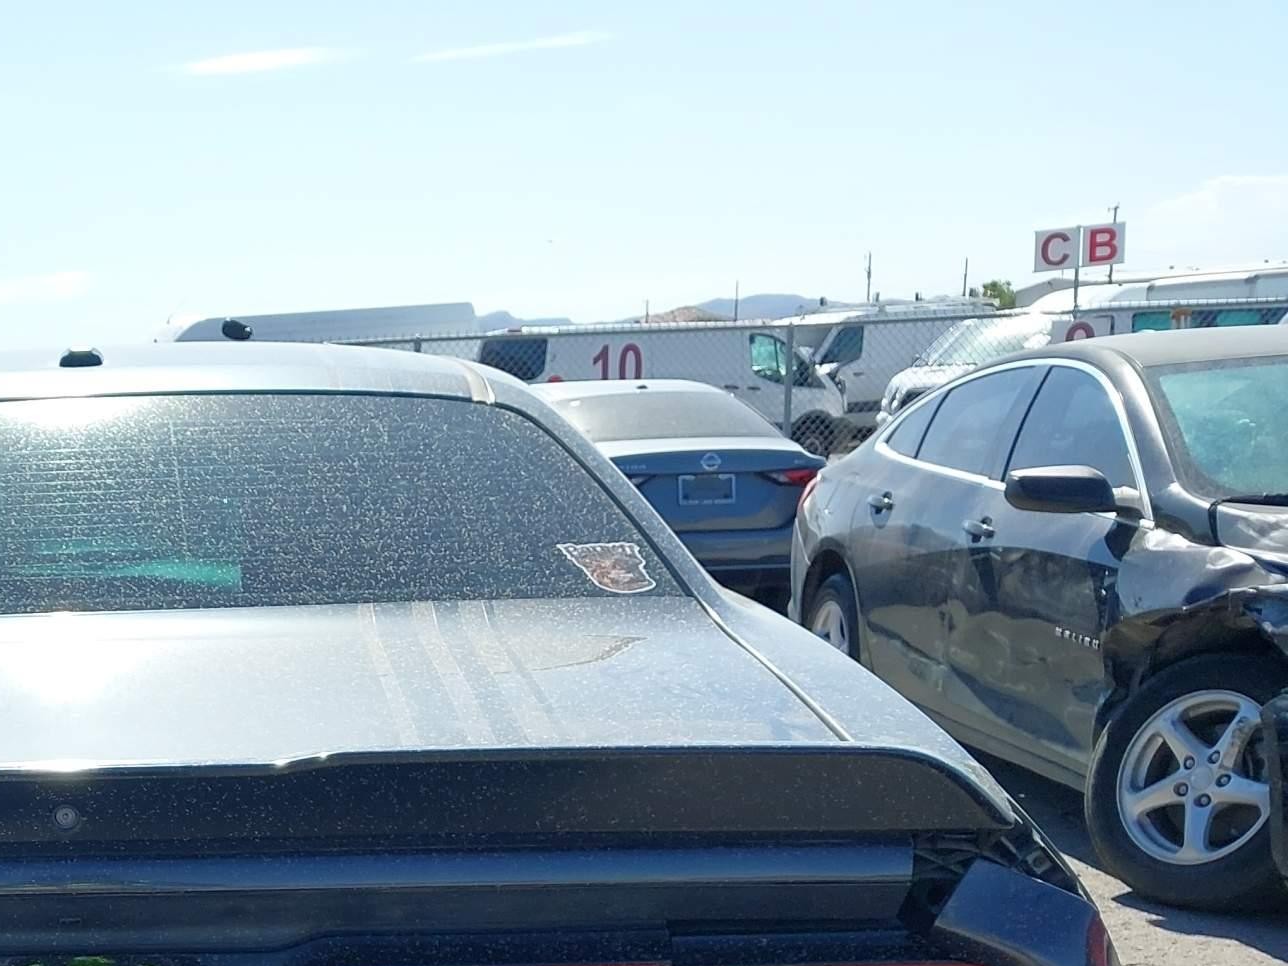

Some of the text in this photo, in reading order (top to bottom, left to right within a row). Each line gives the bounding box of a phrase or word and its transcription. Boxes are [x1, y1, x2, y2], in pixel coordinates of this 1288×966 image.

[1041, 231, 1071, 266] C
[1088, 227, 1118, 263] B
[593, 342, 642, 380] 10
